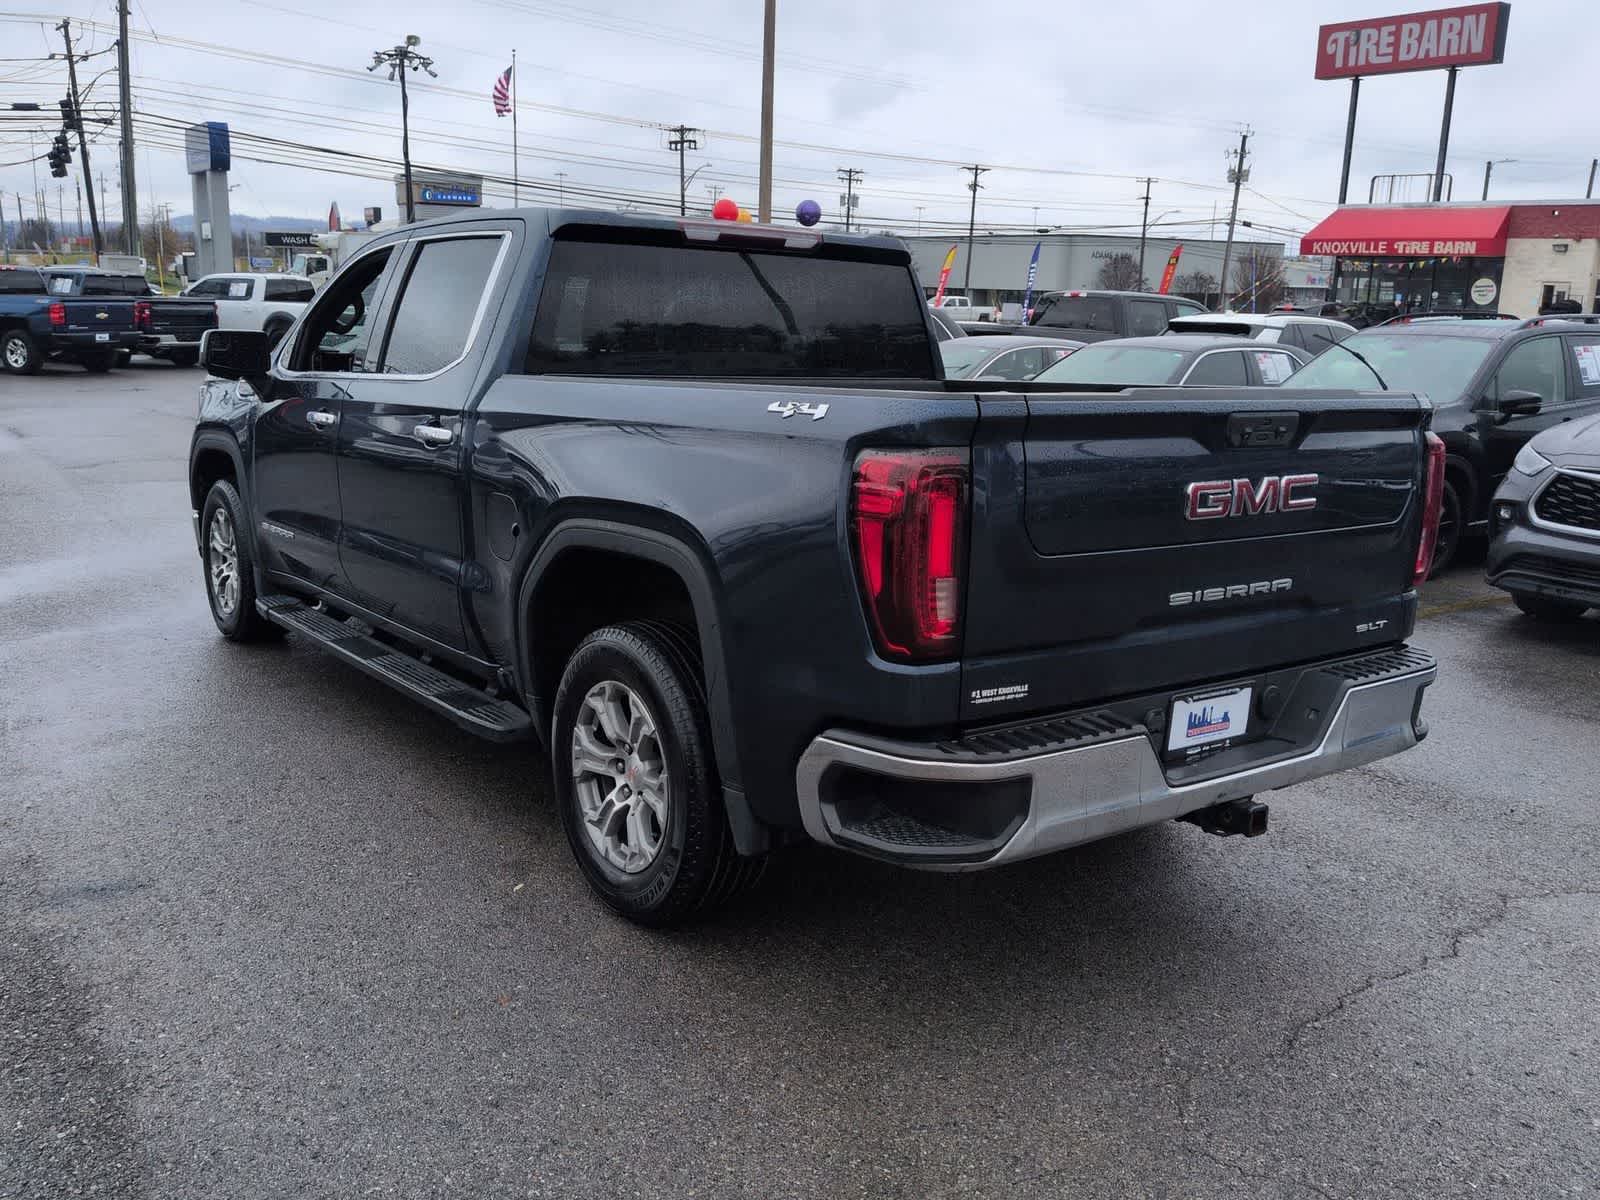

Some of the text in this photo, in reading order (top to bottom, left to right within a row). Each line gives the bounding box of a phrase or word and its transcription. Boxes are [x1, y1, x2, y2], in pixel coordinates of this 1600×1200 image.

[1399, 13, 1487, 62] BARN
[280, 235, 308, 245] WASH
[1312, 241, 1387, 255] KNOXVILLE
[1433, 241, 1477, 255] BARN
[1185, 473, 1319, 520] GMC
[1168, 578, 1294, 606] SIERRA
[1355, 619, 1389, 633] SLT
[971, 690, 981, 699] #1
[981, 689, 997, 697] WEST
[998, 684, 1028, 694] KNOXVILLE
